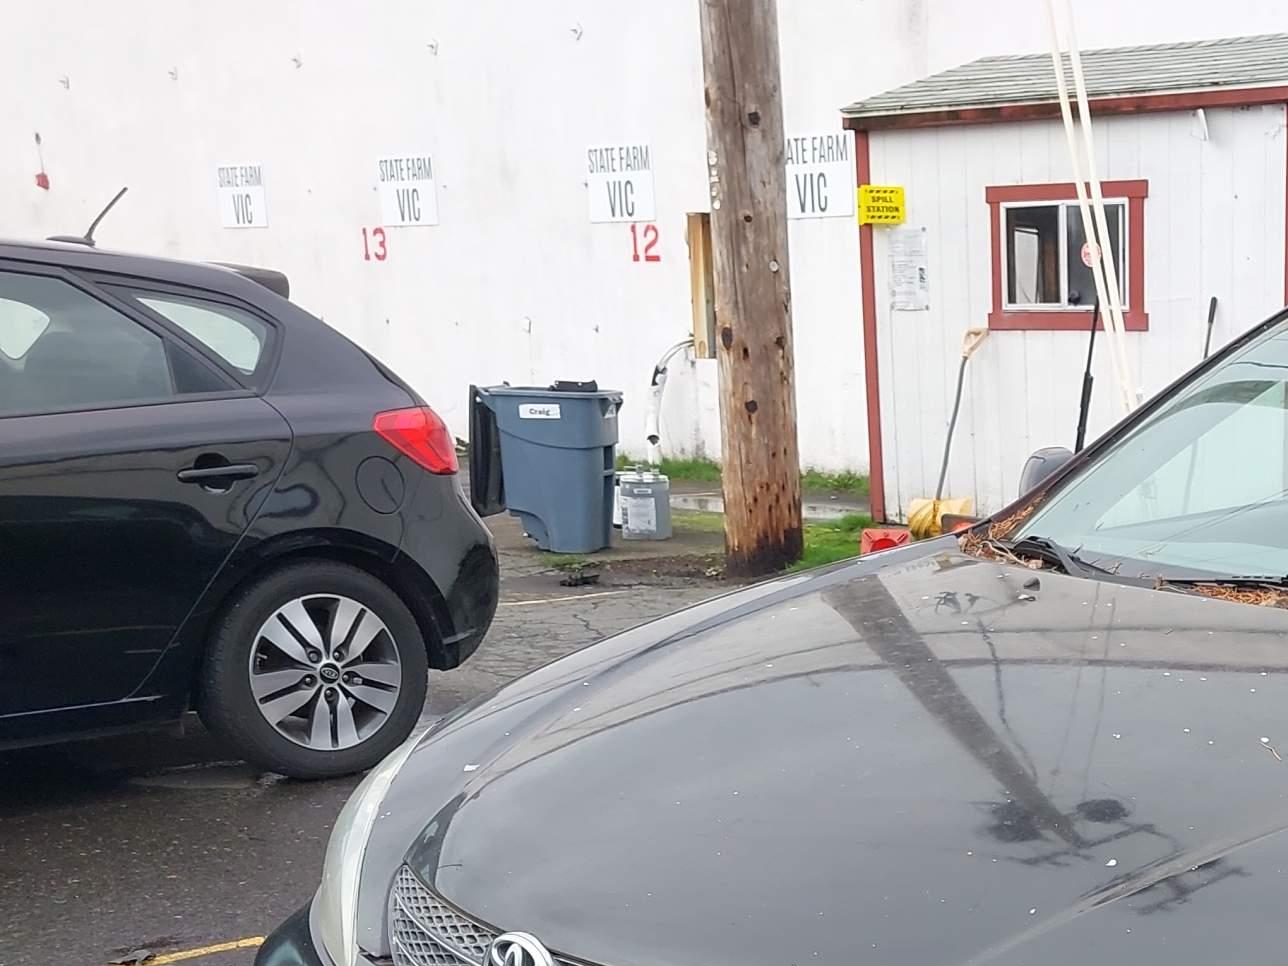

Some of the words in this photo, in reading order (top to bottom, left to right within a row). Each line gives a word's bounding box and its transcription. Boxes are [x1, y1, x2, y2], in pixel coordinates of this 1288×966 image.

[588, 147, 616, 174] STATE
[618, 145, 650, 171] FARM
[786, 137, 807, 165] ATE
[811, 134, 848, 164] FARM
[218, 166, 239, 188] STATE
[240, 165, 262, 187] FARM
[379, 158, 404, 182] STATE
[406, 156, 433, 181] FARM
[232, 193, 253, 224] VIC
[396, 187, 421, 222] VIC
[607, 180, 635, 217] VIC
[795, 172, 828, 214] VIC
[362, 226, 387, 261] 13
[630, 223, 661, 262] 12
